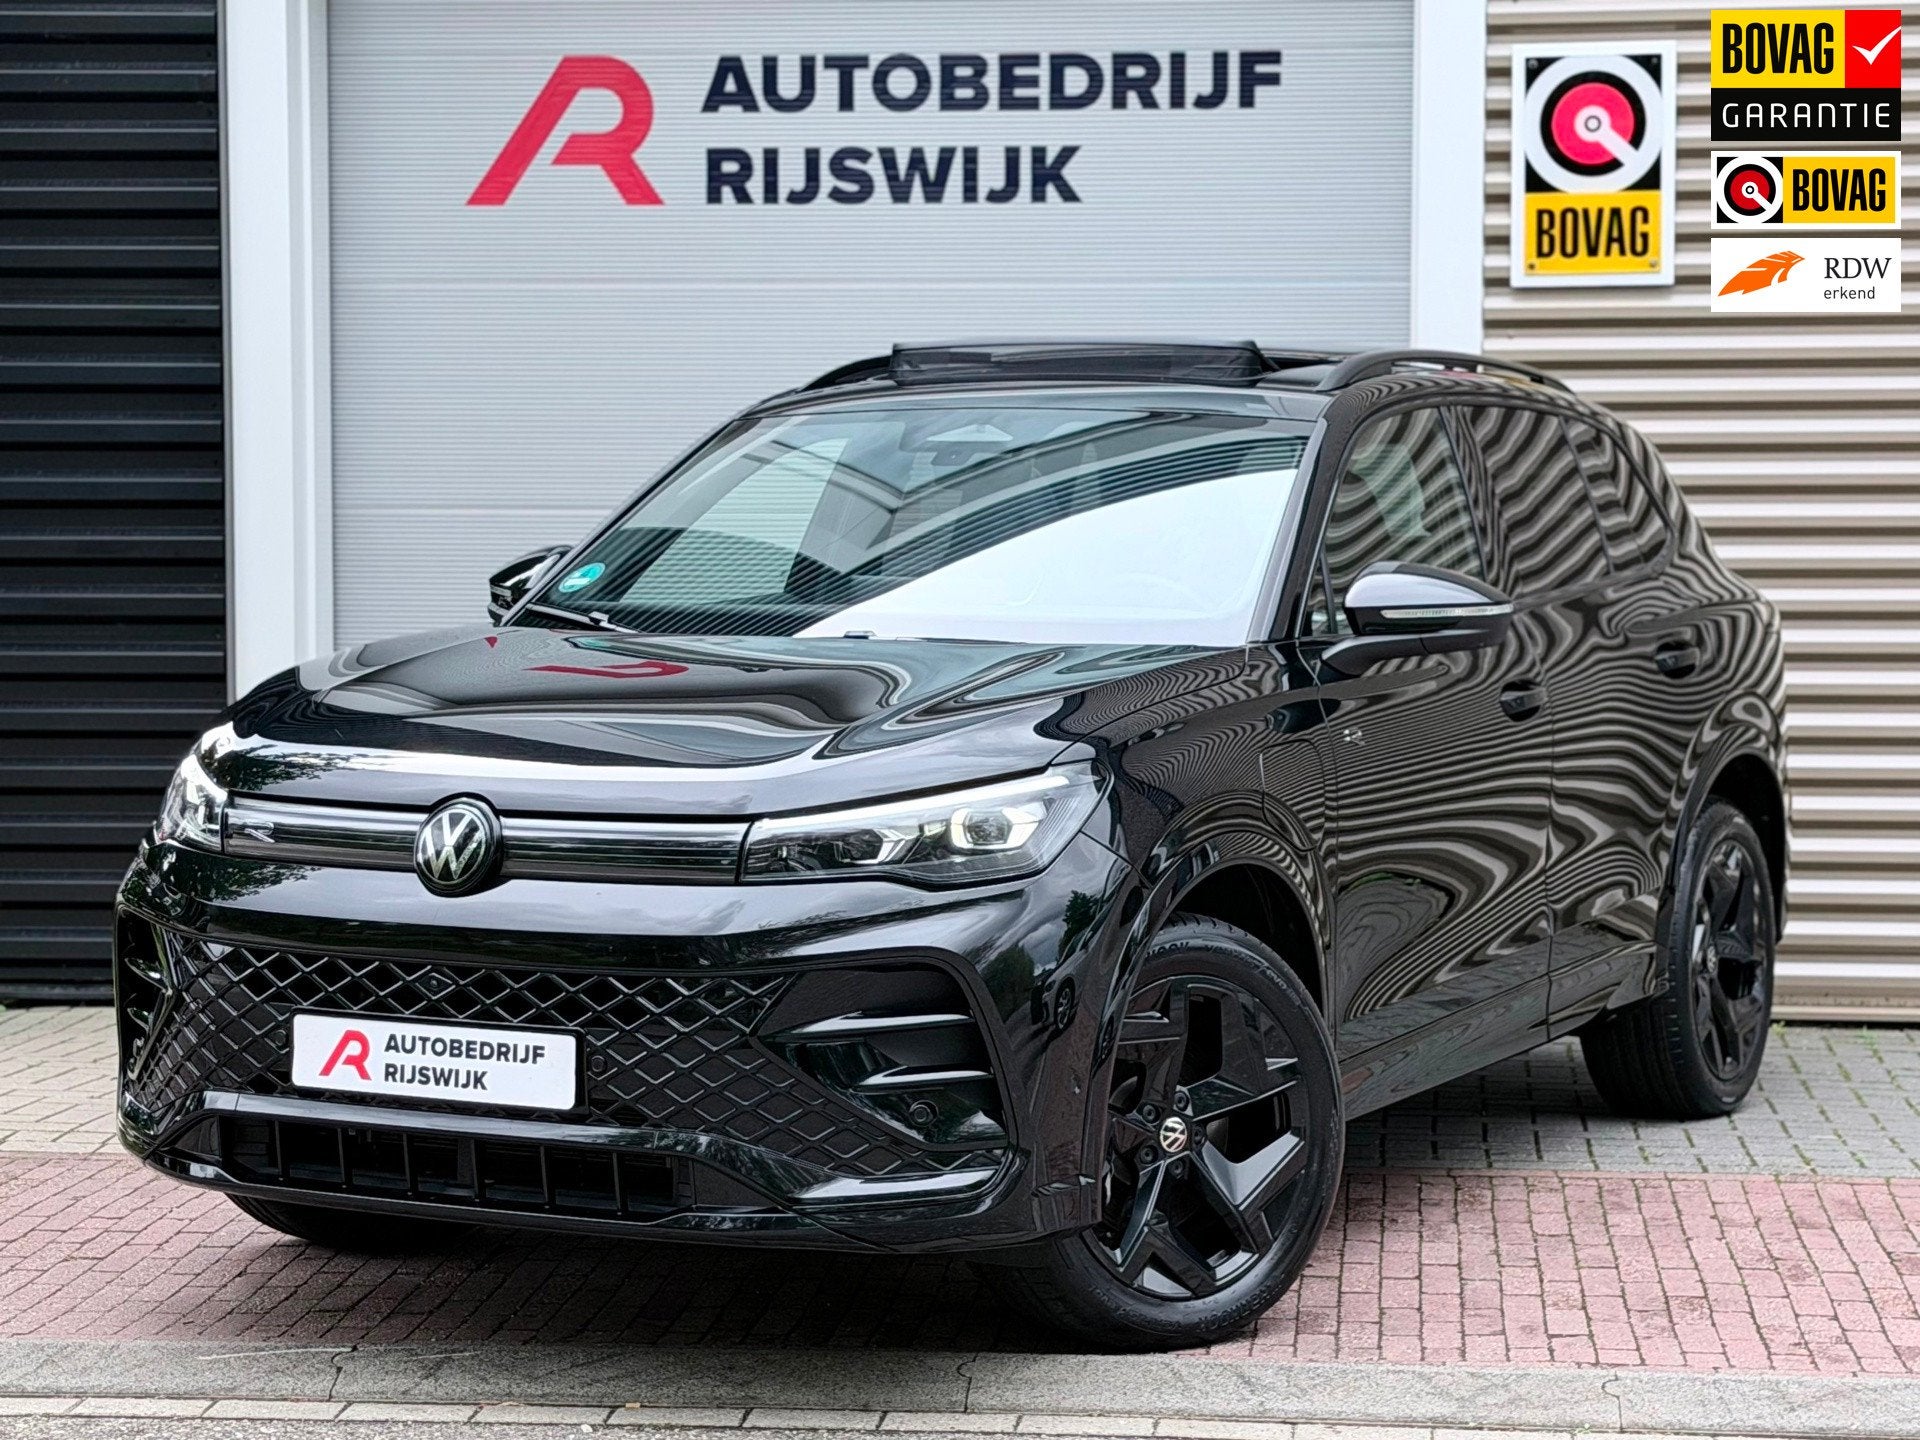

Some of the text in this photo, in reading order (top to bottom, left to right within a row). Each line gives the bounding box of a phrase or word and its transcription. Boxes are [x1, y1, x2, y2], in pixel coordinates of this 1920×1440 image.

[701, 50, 1282, 113] AUTOBEDRIJF
[706, 145, 1082, 205] RIJSWIJK
[1535, 205, 1650, 259] BOVAG
[384, 1033, 546, 1065] AUTOBEDRIJF
[384, 1063, 489, 1091] RIJSWIJK
